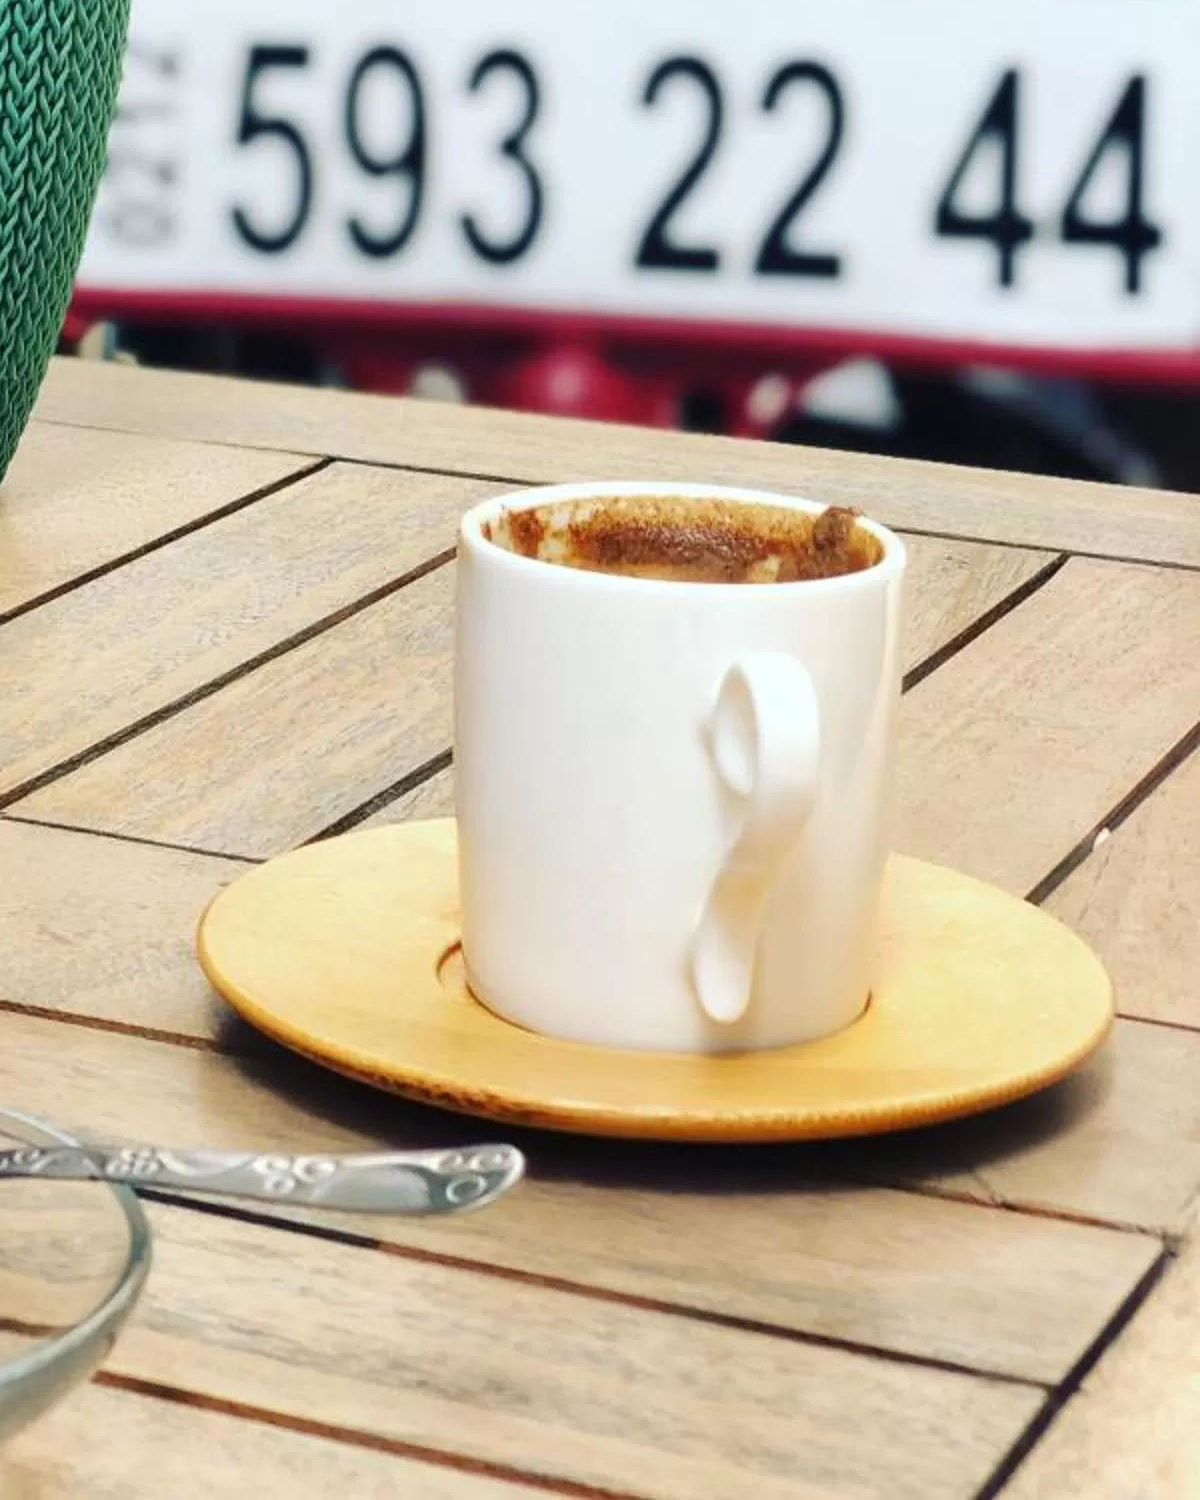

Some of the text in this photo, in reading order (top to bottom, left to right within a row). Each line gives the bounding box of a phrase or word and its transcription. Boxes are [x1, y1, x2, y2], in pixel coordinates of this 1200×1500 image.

[229, 42, 1164, 297] 593 22 44
